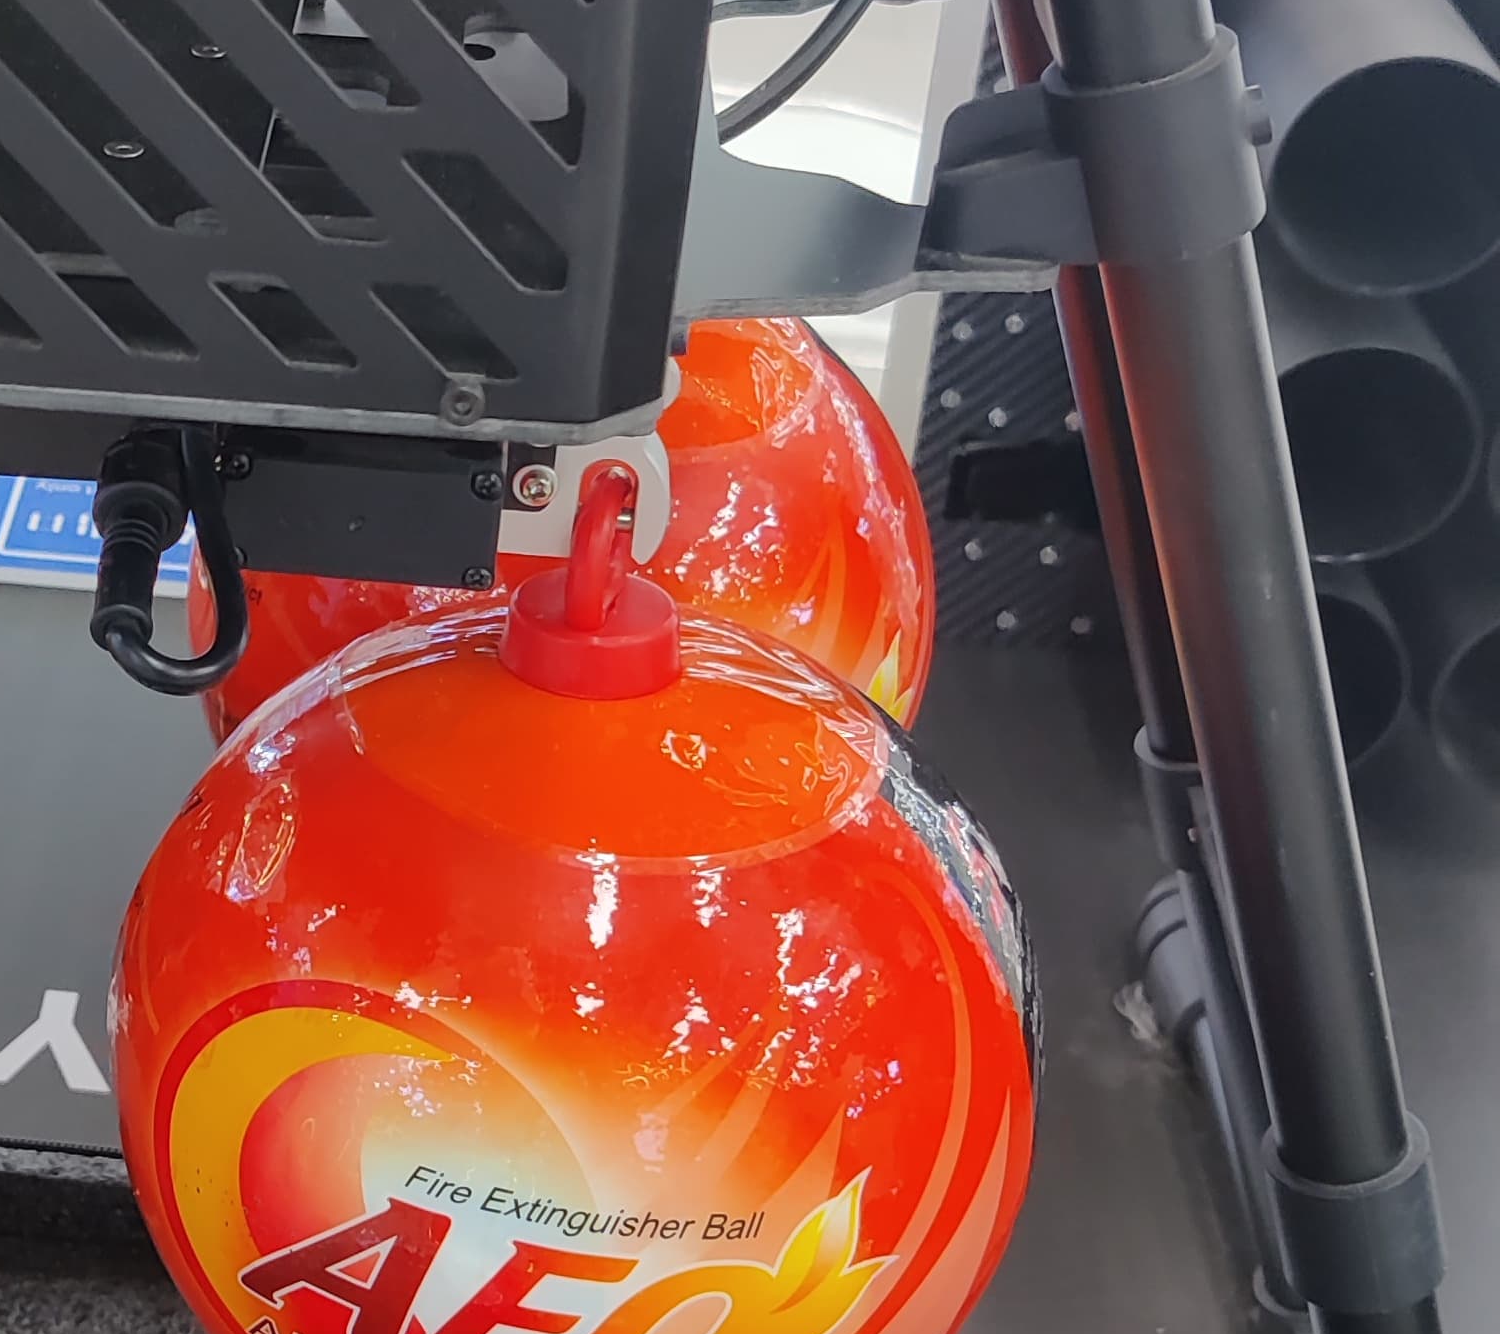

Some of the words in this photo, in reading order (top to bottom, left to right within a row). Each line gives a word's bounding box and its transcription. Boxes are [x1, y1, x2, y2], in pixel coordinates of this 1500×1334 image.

[404, 1164, 473, 1205] Fire
[479, 1185, 697, 1241] Extinguisher
[701, 1210, 765, 1241] Ball
